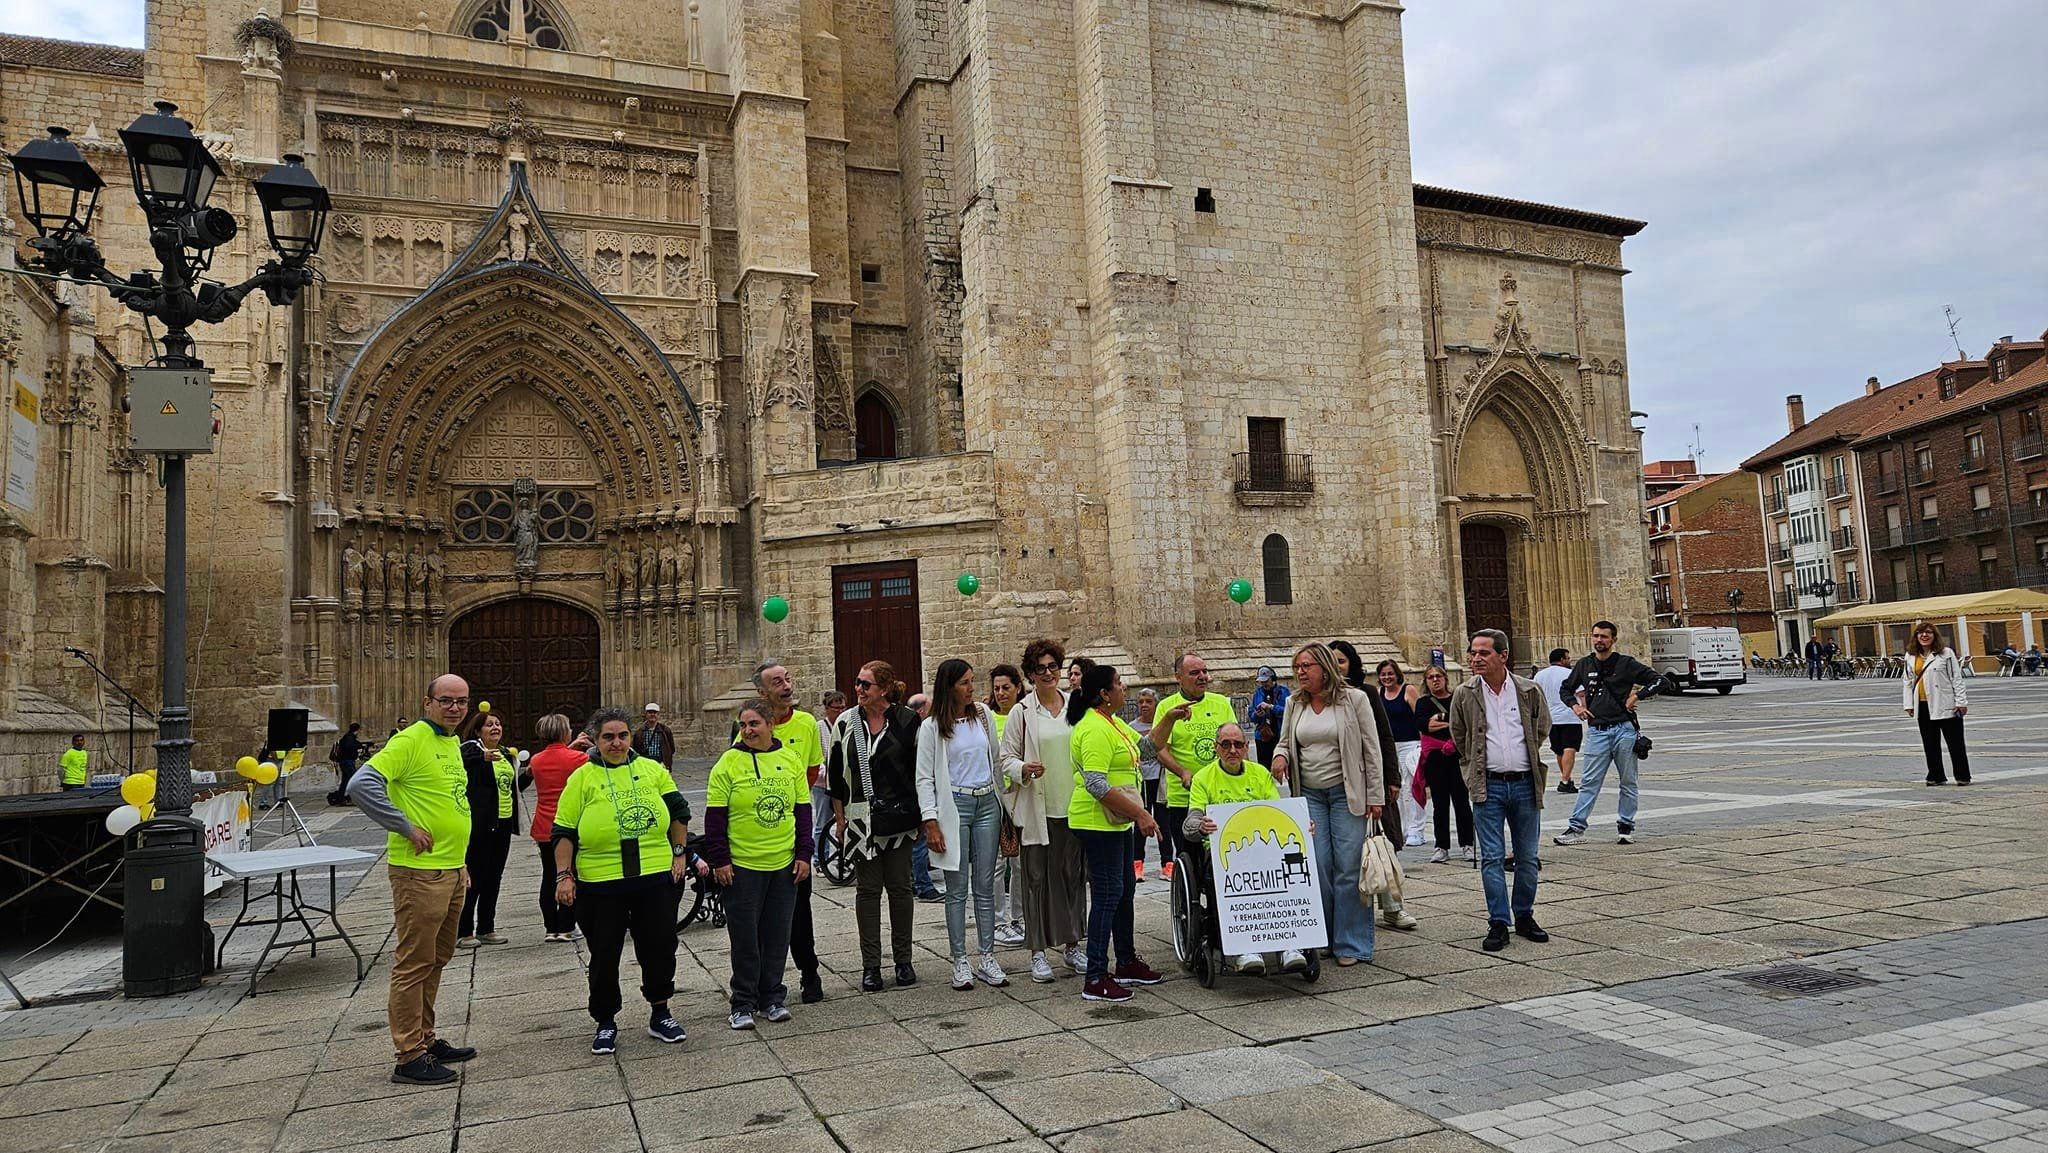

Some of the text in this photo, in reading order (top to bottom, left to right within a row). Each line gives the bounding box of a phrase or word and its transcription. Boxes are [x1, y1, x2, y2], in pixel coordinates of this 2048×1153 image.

[1224, 869, 1284, 893] ACREMIF
[1230, 898, 1311, 912] ASOCIACIÓN CULTURAL
[1240, 910, 1298, 921] REHABILITADORA
[1300, 908, 1310, 916] DE
[1228, 918, 1318, 933] DISCAPACITADOS FÍSICOS
[1251, 931, 1297, 942] DE PALENCIA
